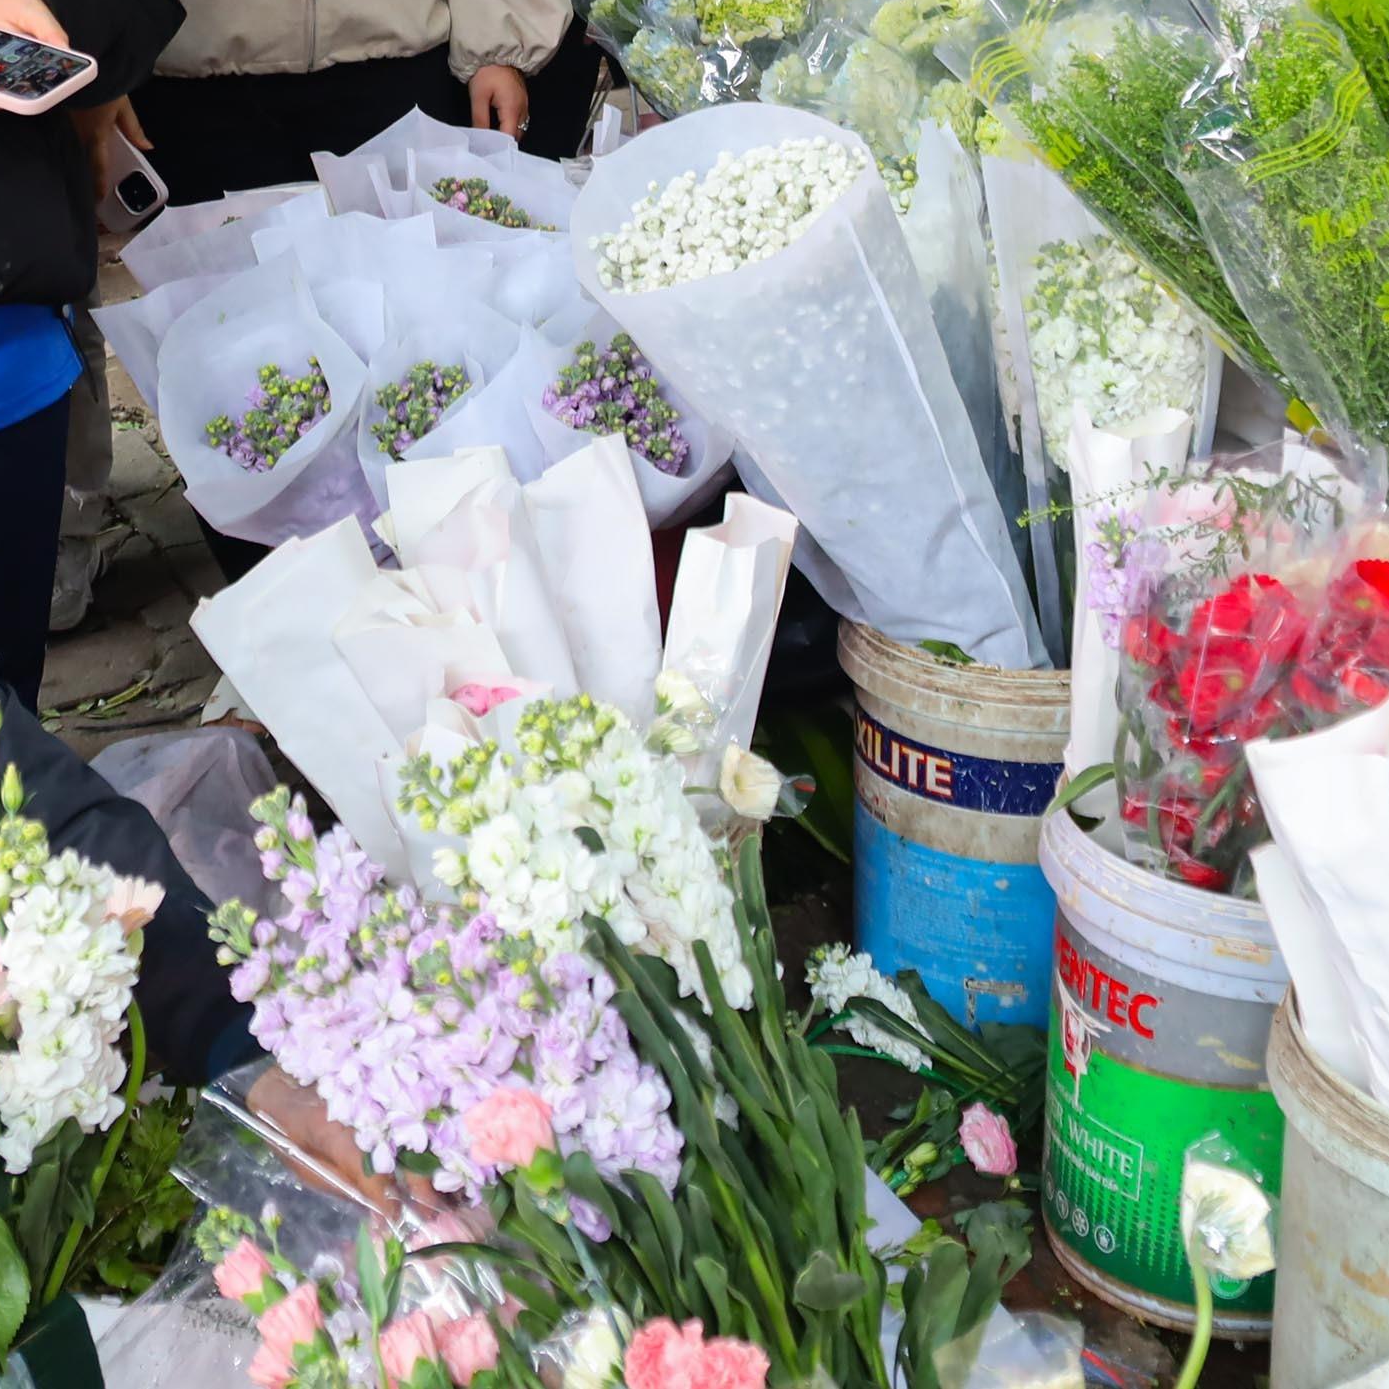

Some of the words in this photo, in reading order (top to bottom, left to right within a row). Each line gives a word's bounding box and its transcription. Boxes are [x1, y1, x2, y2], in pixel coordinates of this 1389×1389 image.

[854, 710, 954, 800] XILITE
[1055, 930, 1159, 1040] ENTEC
[1068, 1114, 1134, 1180] WHITE
